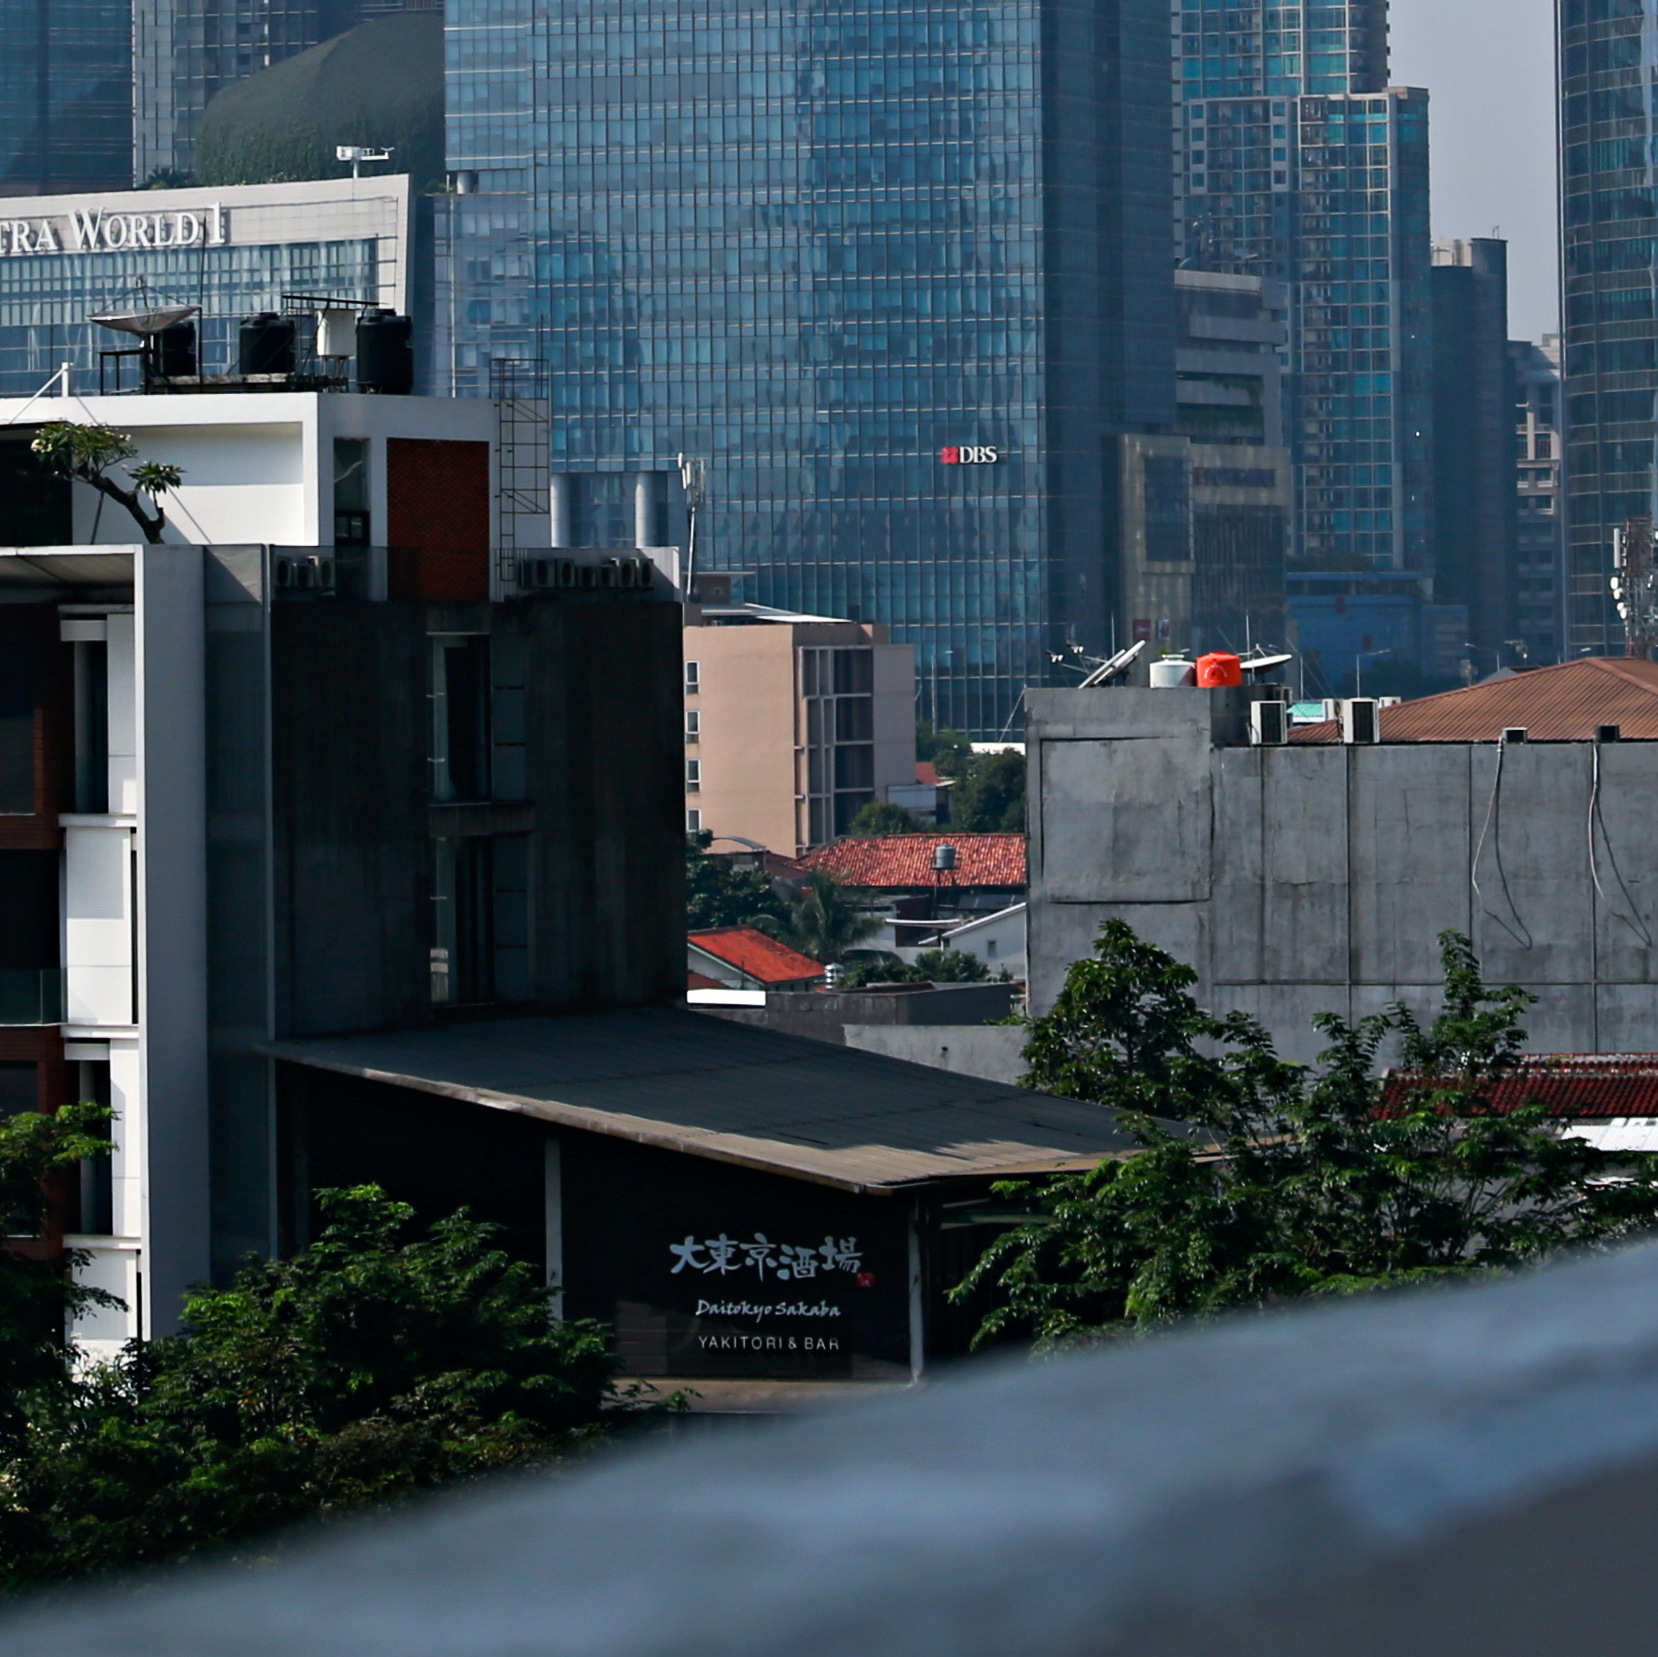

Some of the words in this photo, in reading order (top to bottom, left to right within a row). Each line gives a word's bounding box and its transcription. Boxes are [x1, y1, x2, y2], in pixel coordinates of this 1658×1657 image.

[208, 201, 226, 245] 1
[959, 446, 998, 464] DBS
[669, 1232, 864, 1282] 大東京酒場
[695, 1298, 773, 1323] Daitokyo
[775, 1299, 842, 1318] Sakaba
[698, 1335, 783, 1351] YAKITORI
[788, 1336, 797, 1350] &
[804, 1336, 840, 1351] BAR
